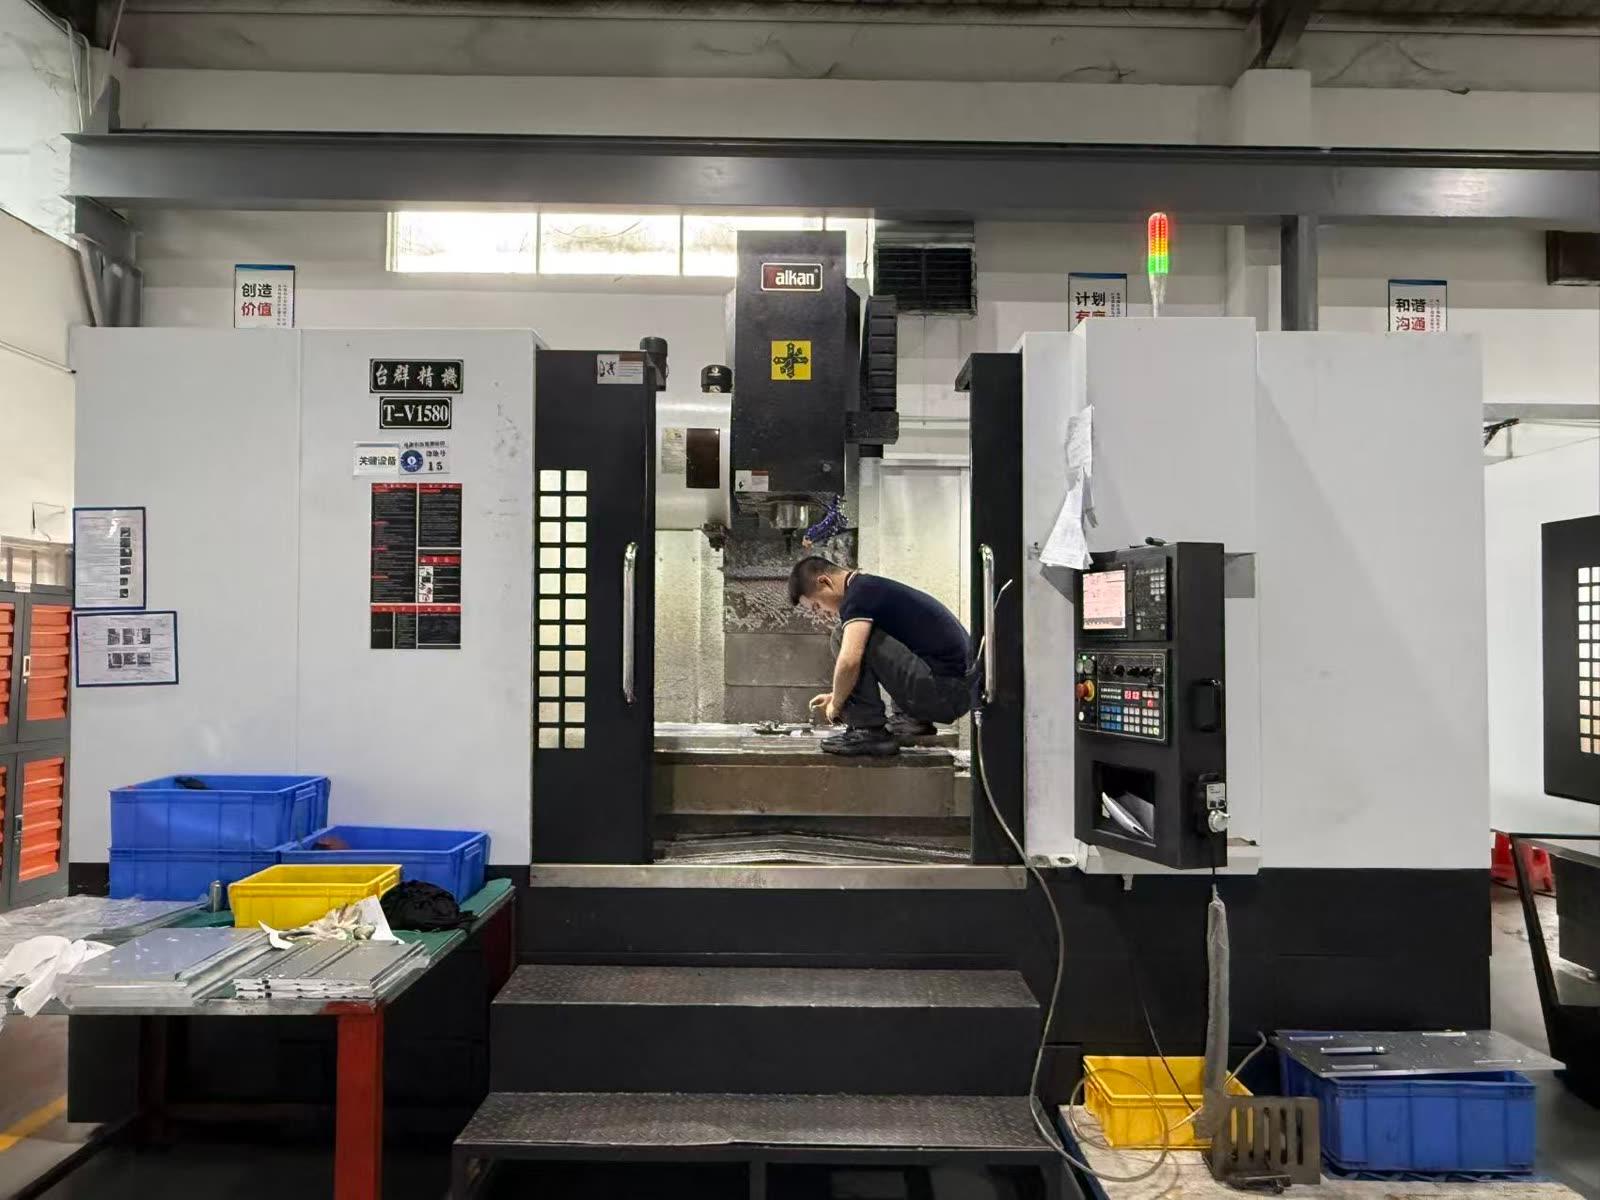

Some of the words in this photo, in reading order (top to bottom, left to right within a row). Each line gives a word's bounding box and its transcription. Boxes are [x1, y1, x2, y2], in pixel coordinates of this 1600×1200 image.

[241, 283, 272, 298] 创造
[1075, 291, 1106, 307] 计划
[1395, 298, 1426, 313] 和谐
[241, 301, 272, 317] 价值
[1395, 316, 1426, 331] 沟通
[383, 404, 449, 422] T-V1580
[428, 461, 444, 472] 15
